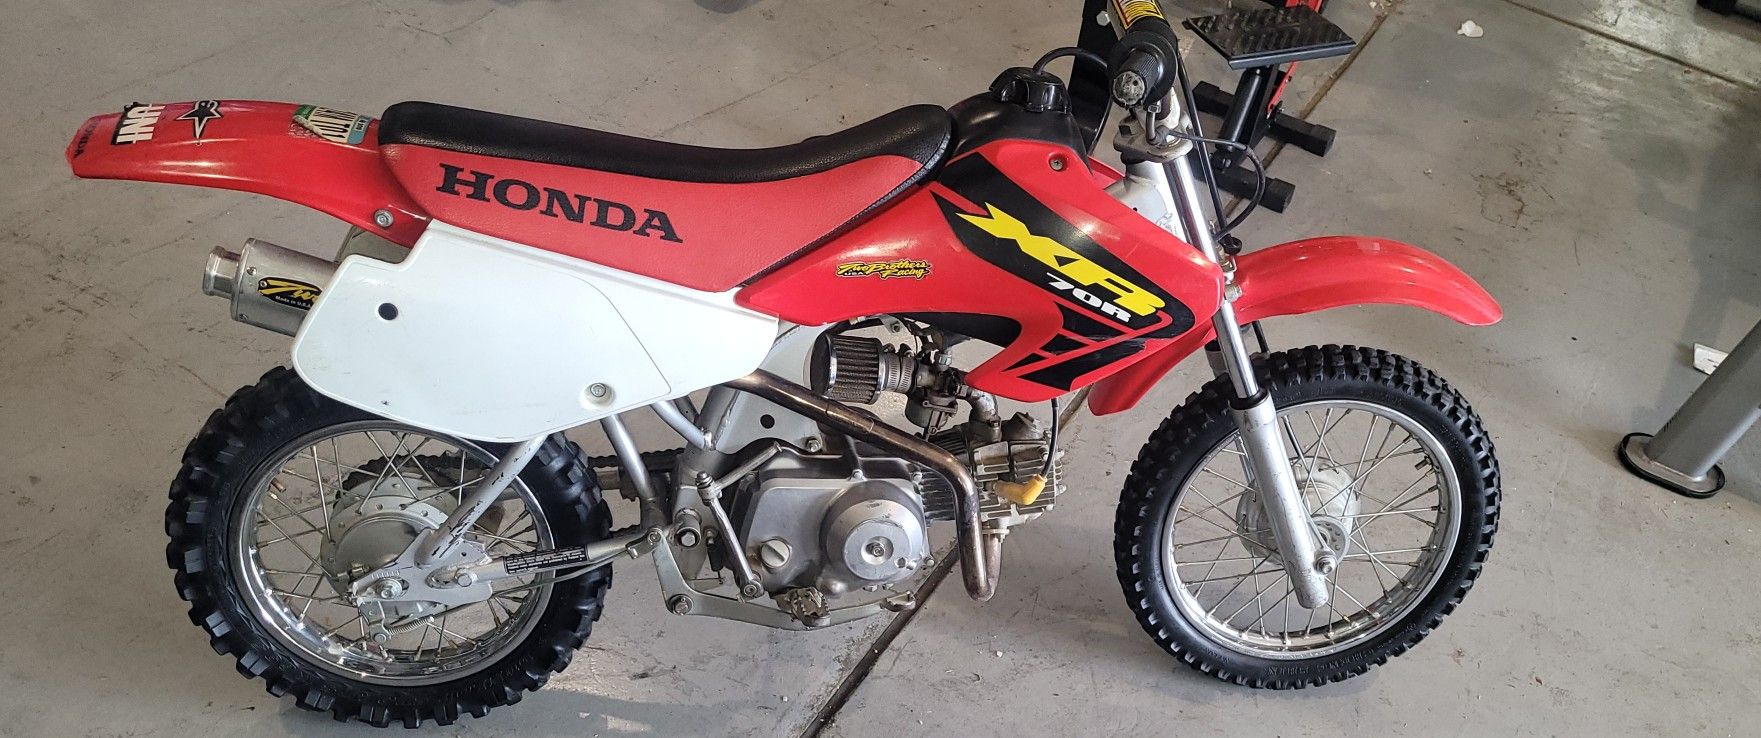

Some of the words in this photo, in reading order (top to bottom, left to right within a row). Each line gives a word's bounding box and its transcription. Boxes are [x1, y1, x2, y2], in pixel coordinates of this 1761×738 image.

[436, 163, 683, 243] HONDA
[865, 260, 927, 275] Brothers
[880, 268, 925, 279] Racing
[955, 202, 1166, 317] XR
[1046, 272, 1132, 322] 70R
